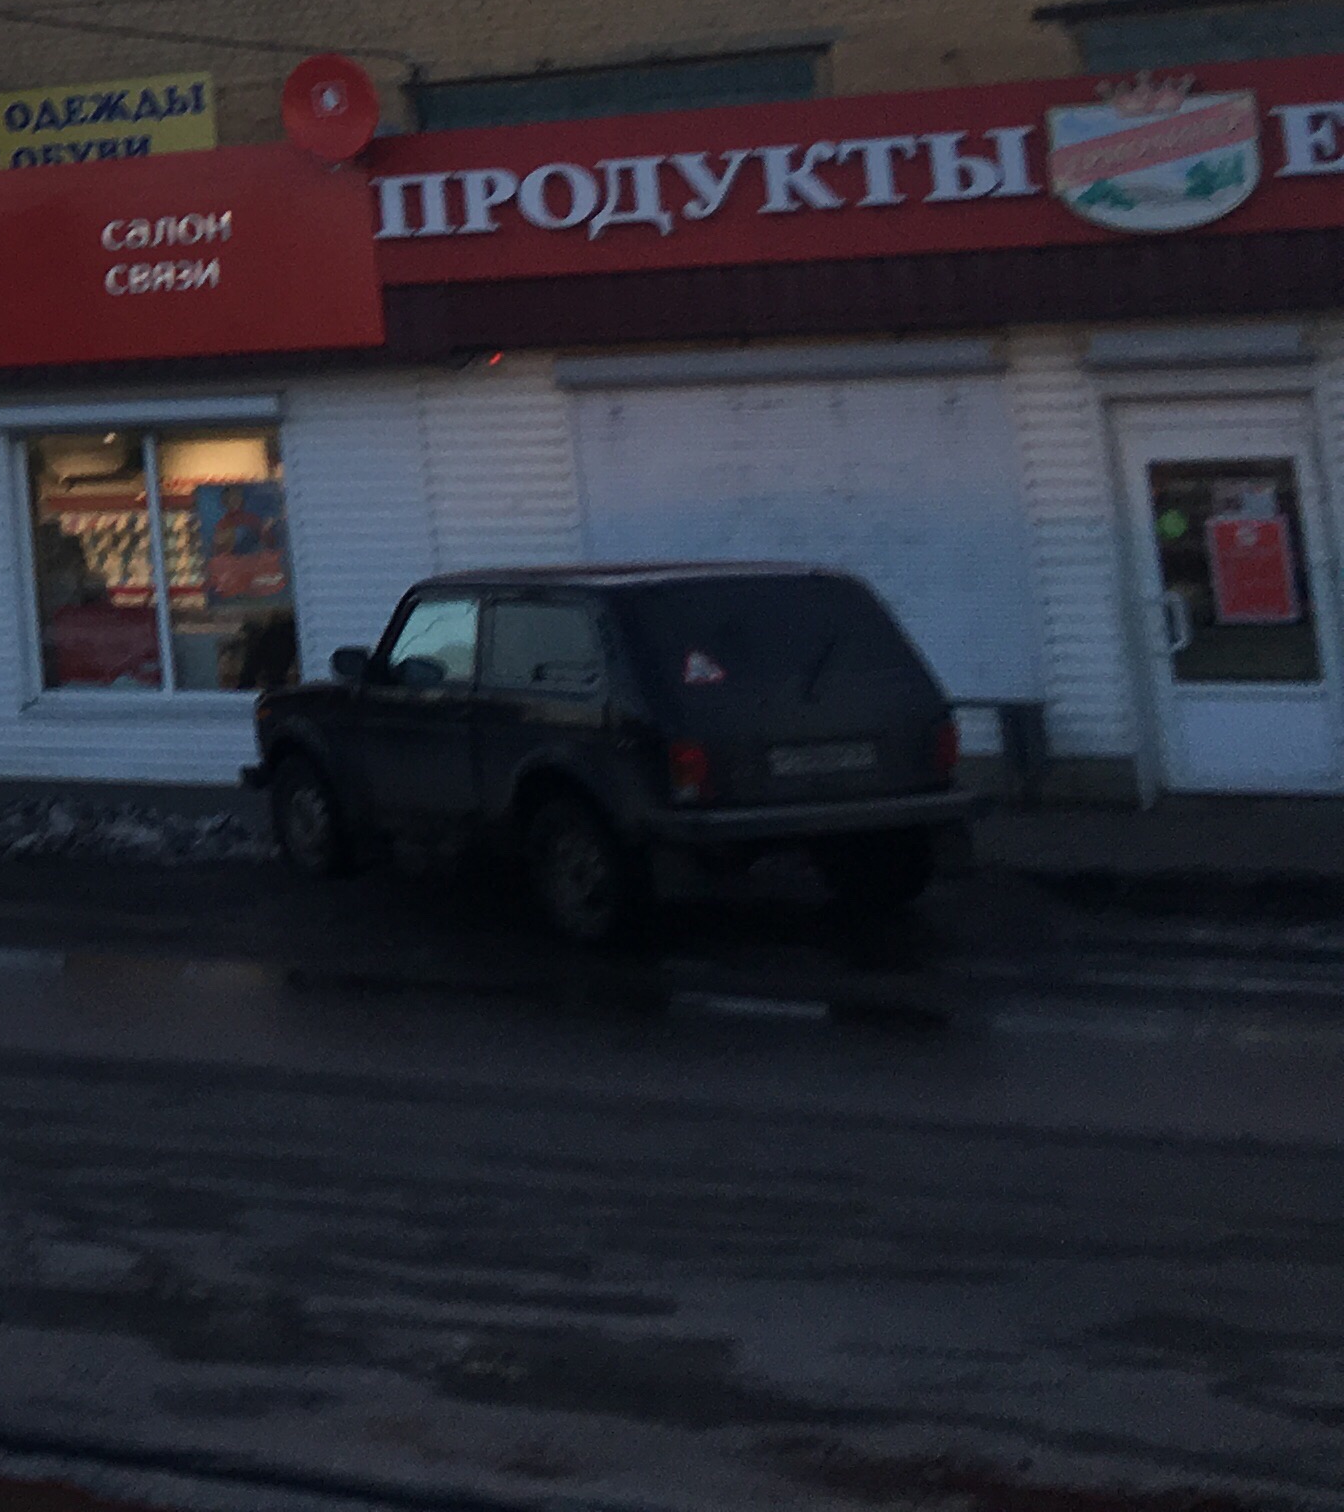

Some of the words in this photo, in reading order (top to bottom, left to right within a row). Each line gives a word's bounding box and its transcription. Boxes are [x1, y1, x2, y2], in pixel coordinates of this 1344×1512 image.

[4, 82, 206, 133] ОДЕЖДЫ
[374, 124, 1041, 242] ПРОДУКТЫ
[101, 210, 232, 252] салон
[104, 257, 220, 296] связи
